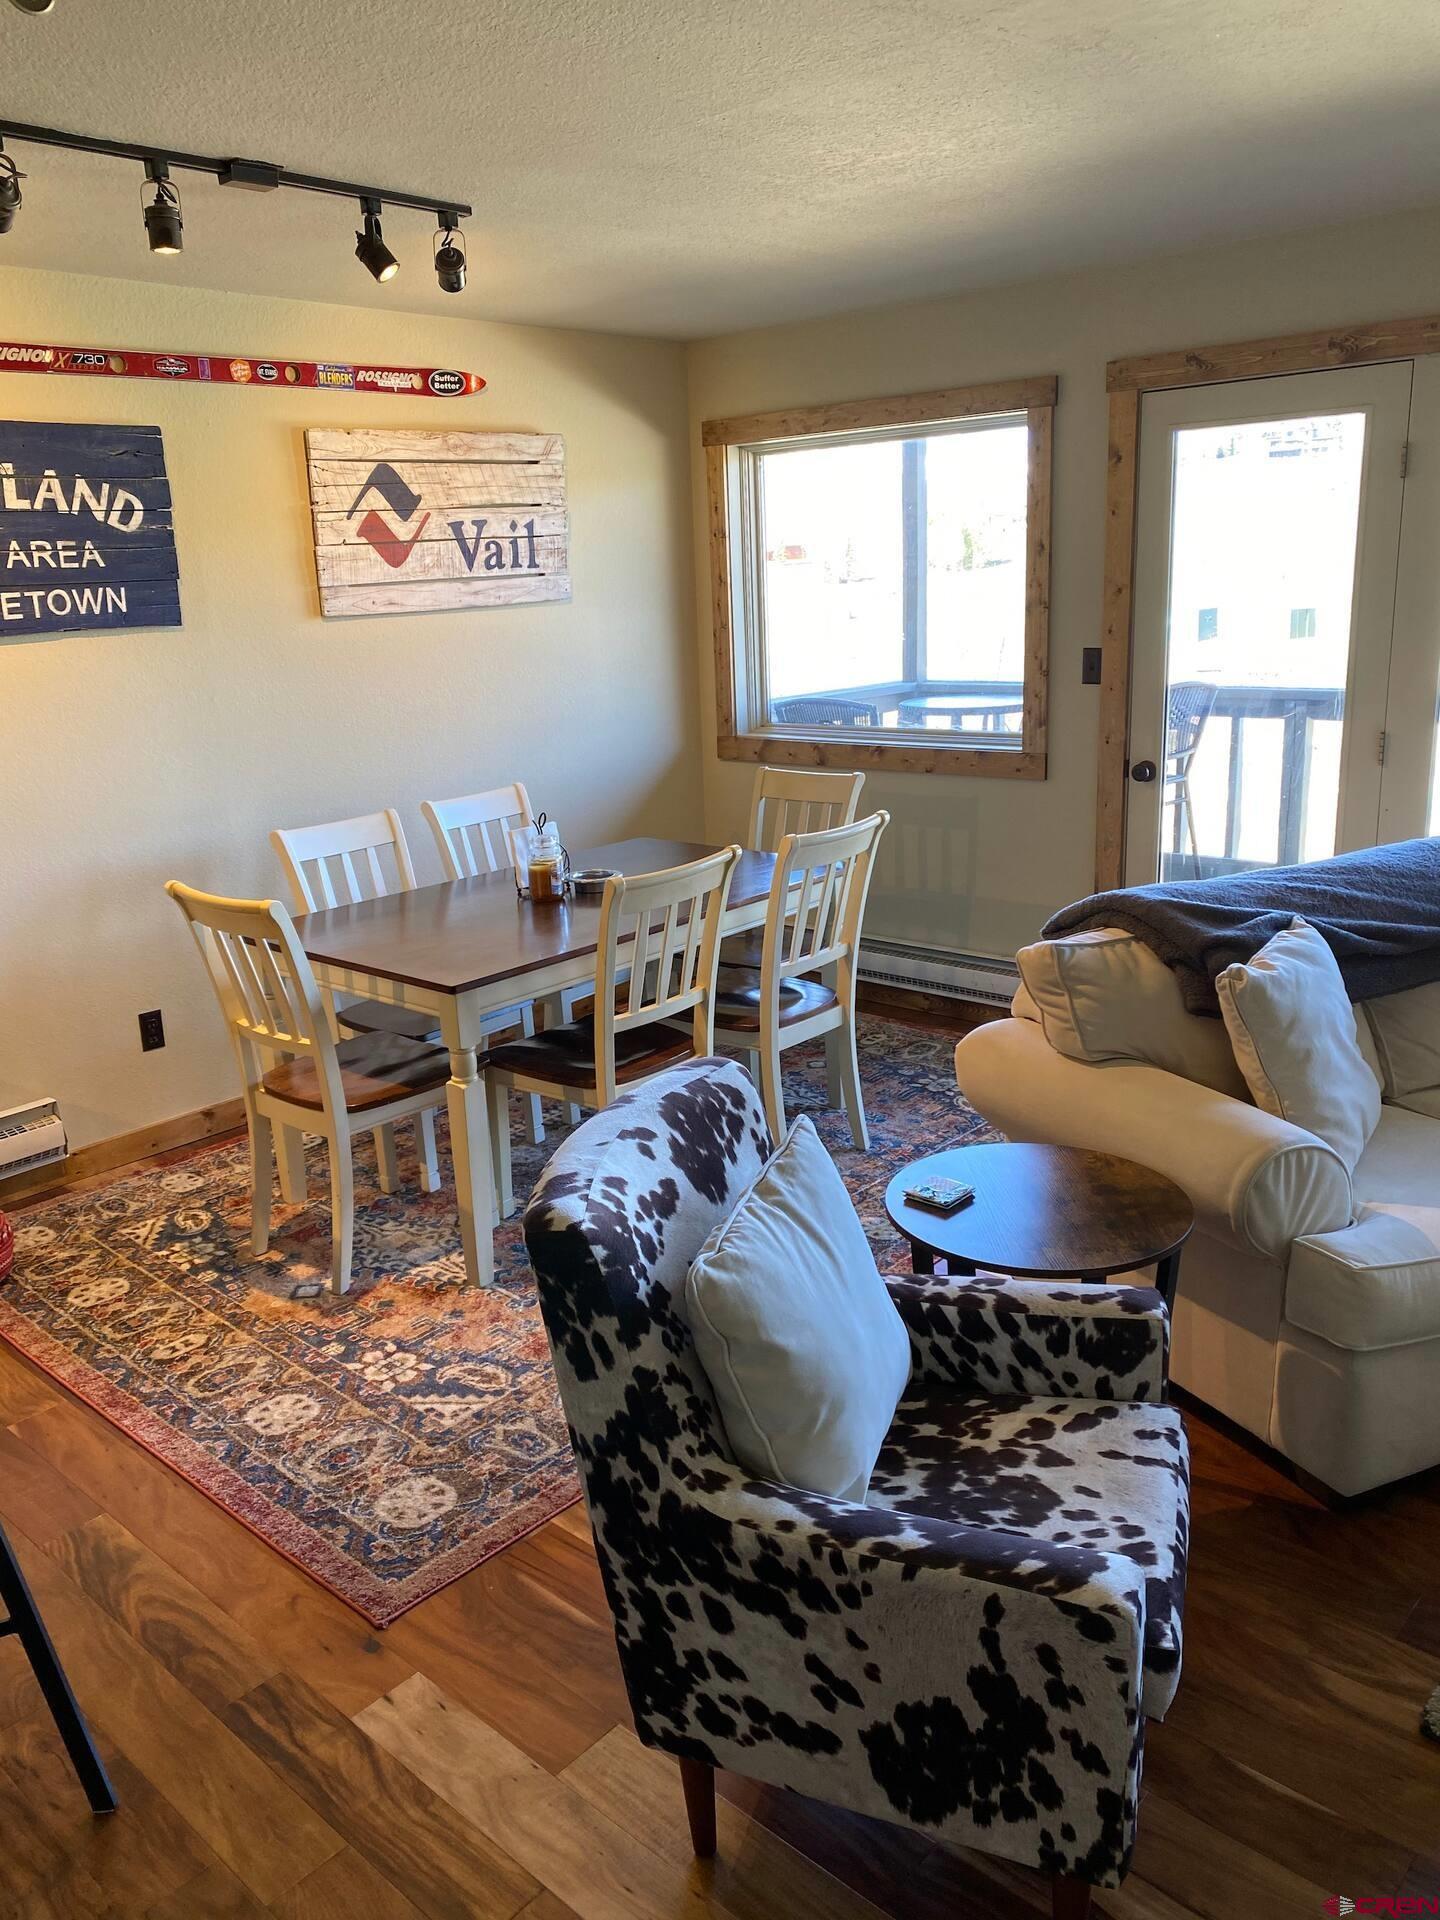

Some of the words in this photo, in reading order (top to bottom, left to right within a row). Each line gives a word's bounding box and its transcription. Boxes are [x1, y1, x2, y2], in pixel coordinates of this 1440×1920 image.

[54, 352, 71, 368] X
[73, 353, 105, 365] 730
[319, 371, 353, 386] BLENDERS
[356, 370, 421, 385] ROSSIGNO
[433, 374, 459, 382] Suffer
[433, 382, 460, 390] Better
[447, 518, 540, 573] Vail
[6, 540, 106, 569] AREA
[0, 587, 127, 620] ETOWN
